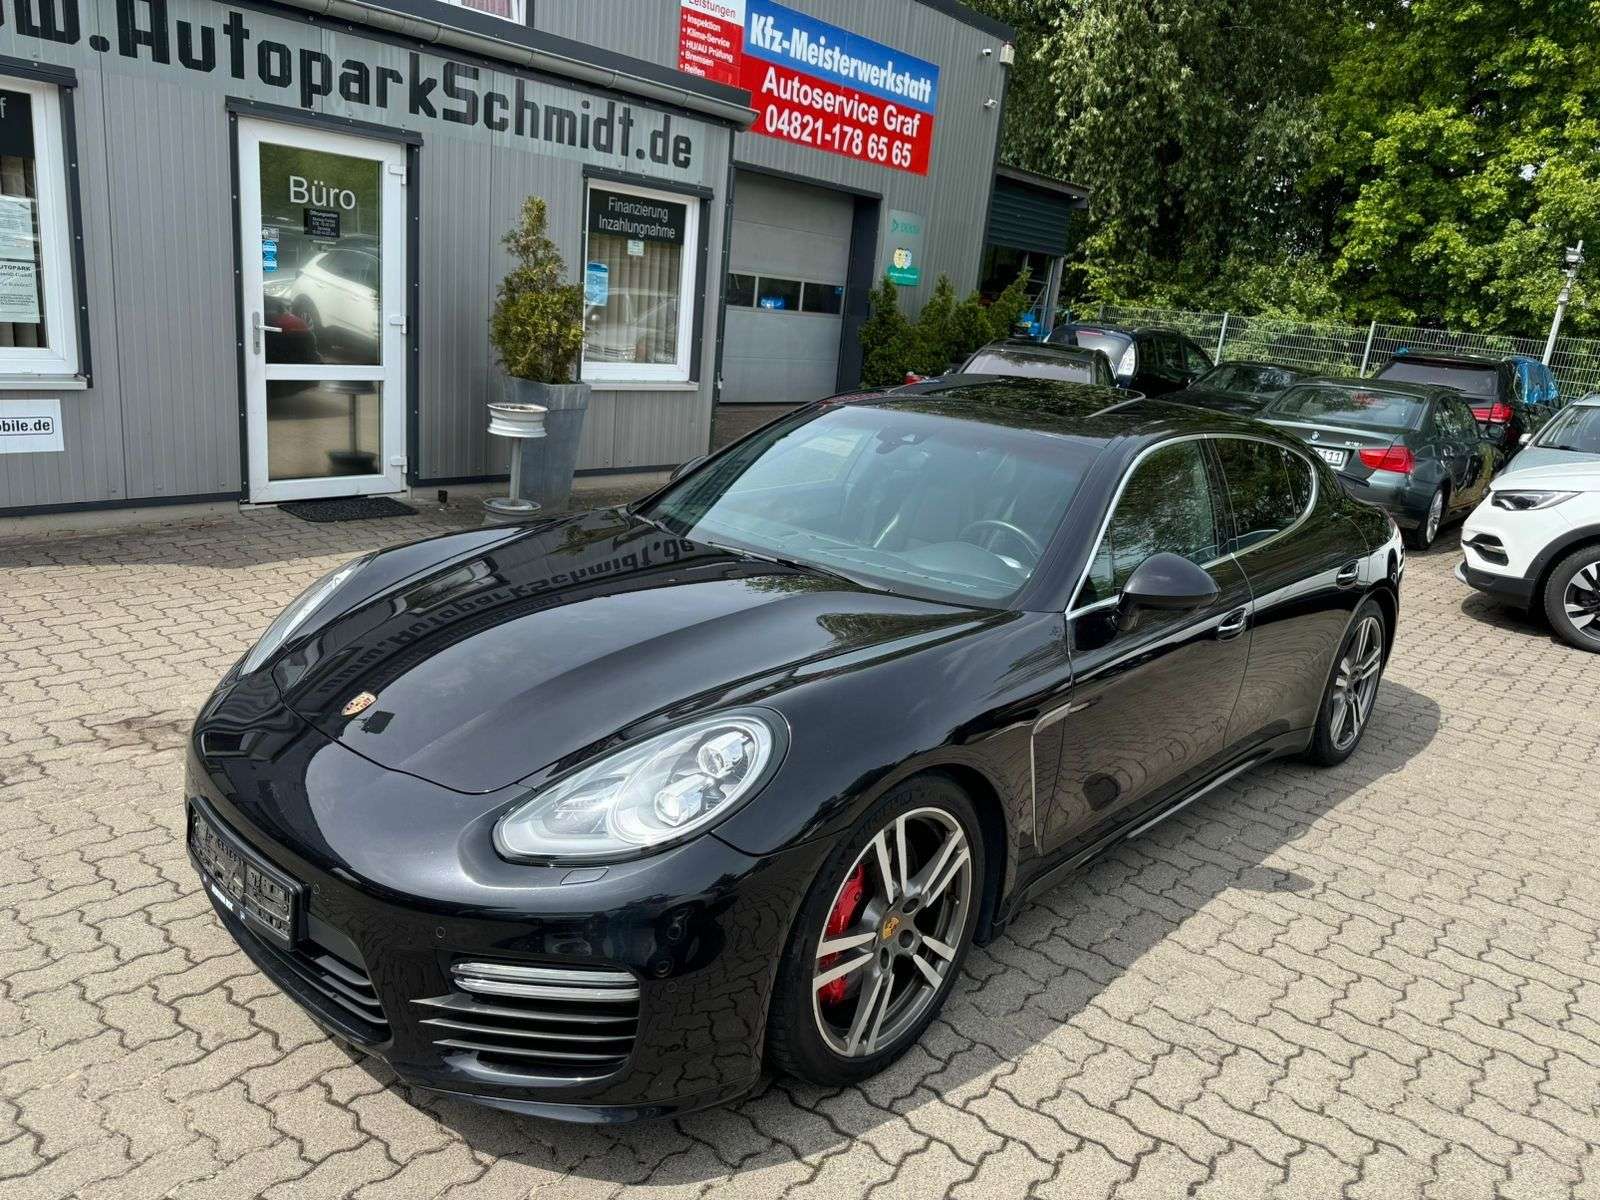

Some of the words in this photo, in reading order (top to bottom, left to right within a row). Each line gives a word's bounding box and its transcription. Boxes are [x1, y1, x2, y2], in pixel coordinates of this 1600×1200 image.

[751, 13, 932, 104] Kfz-Meisterwerkstatt
[0, 0, 691, 169] w.AutoparkSchmidt.de
[762, 66, 879, 126] Autoservice
[883, 104, 921, 138] Graf
[765, 104, 862, 155] 04821-178
[867, 134, 888, 162] 65
[891, 141, 912, 168] 65
[289, 175, 356, 210] Büro
[608, 196, 669, 223] Finanzierung
[598, 214, 676, 239] Inzahlungnahme
[0, 419, 51, 432] bile.de
